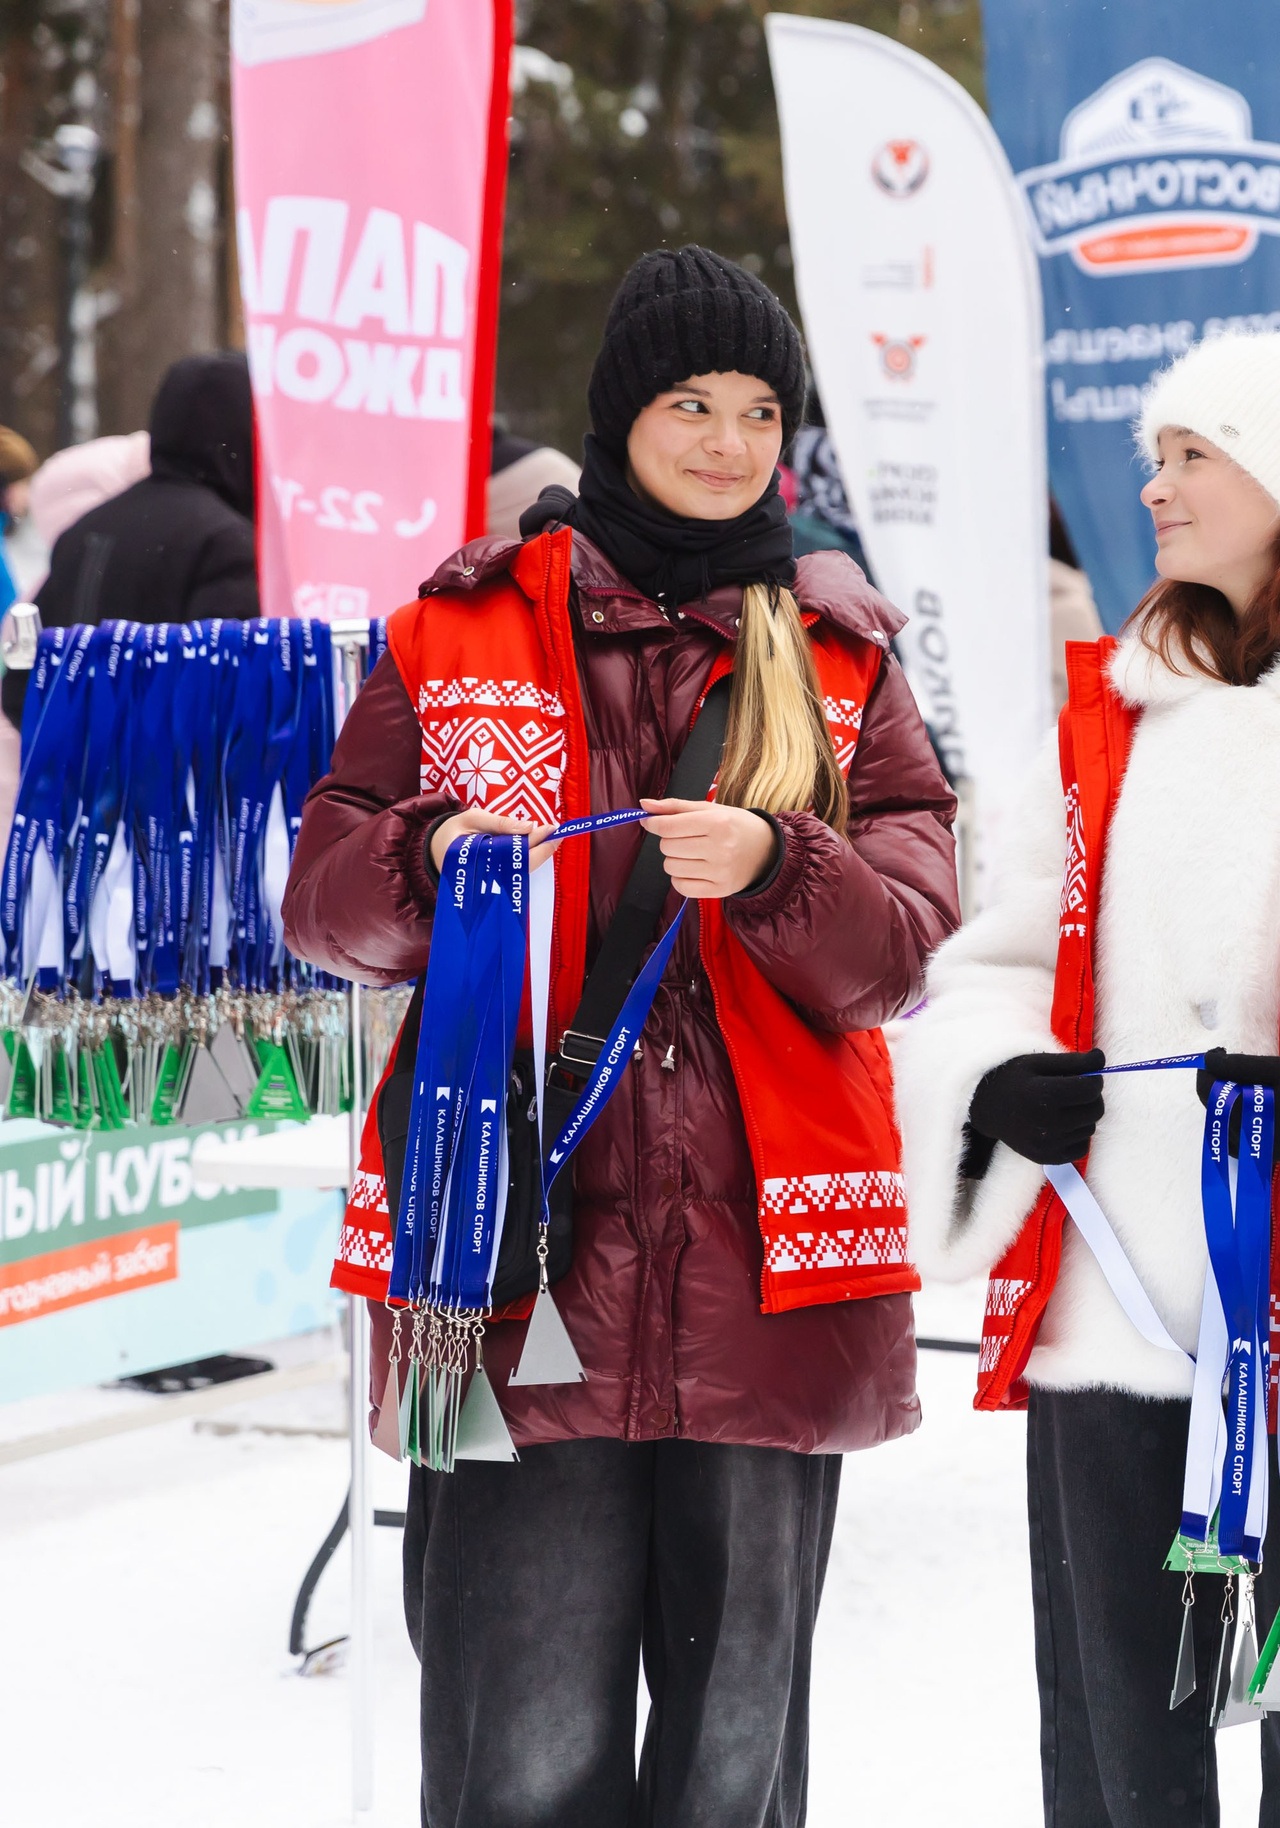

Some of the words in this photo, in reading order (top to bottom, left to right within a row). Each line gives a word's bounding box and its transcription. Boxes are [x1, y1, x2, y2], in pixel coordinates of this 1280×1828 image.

[553, 821, 592, 836] СПОРТ
[453, 868, 467, 909] СПОРТ
[512, 873, 523, 915] СПОРТ
[1160, 1055, 1199, 1064] СПОРТ
[561, 1066, 613, 1145] КАЛАШНИКОВ
[607, 1026, 631, 1065] СПОРТ
[432, 1109, 447, 1197] КАЛАШНИКОВ
[1210, 1120, 1221, 1163] СПОРТ
[1249, 1116, 1263, 1159] СПОРТ
[476, 1121, 492, 1211] КАЛАШНИКОВ
[0, 1138, 87, 1240] ЫЙ
[429, 1200, 439, 1240] СПОРТ
[471, 1214, 485, 1254] СПОРТ
[1234, 1362, 1249, 1452] КАЛАШНИКОВ
[1231, 1454, 1244, 1496] СПОРТ
